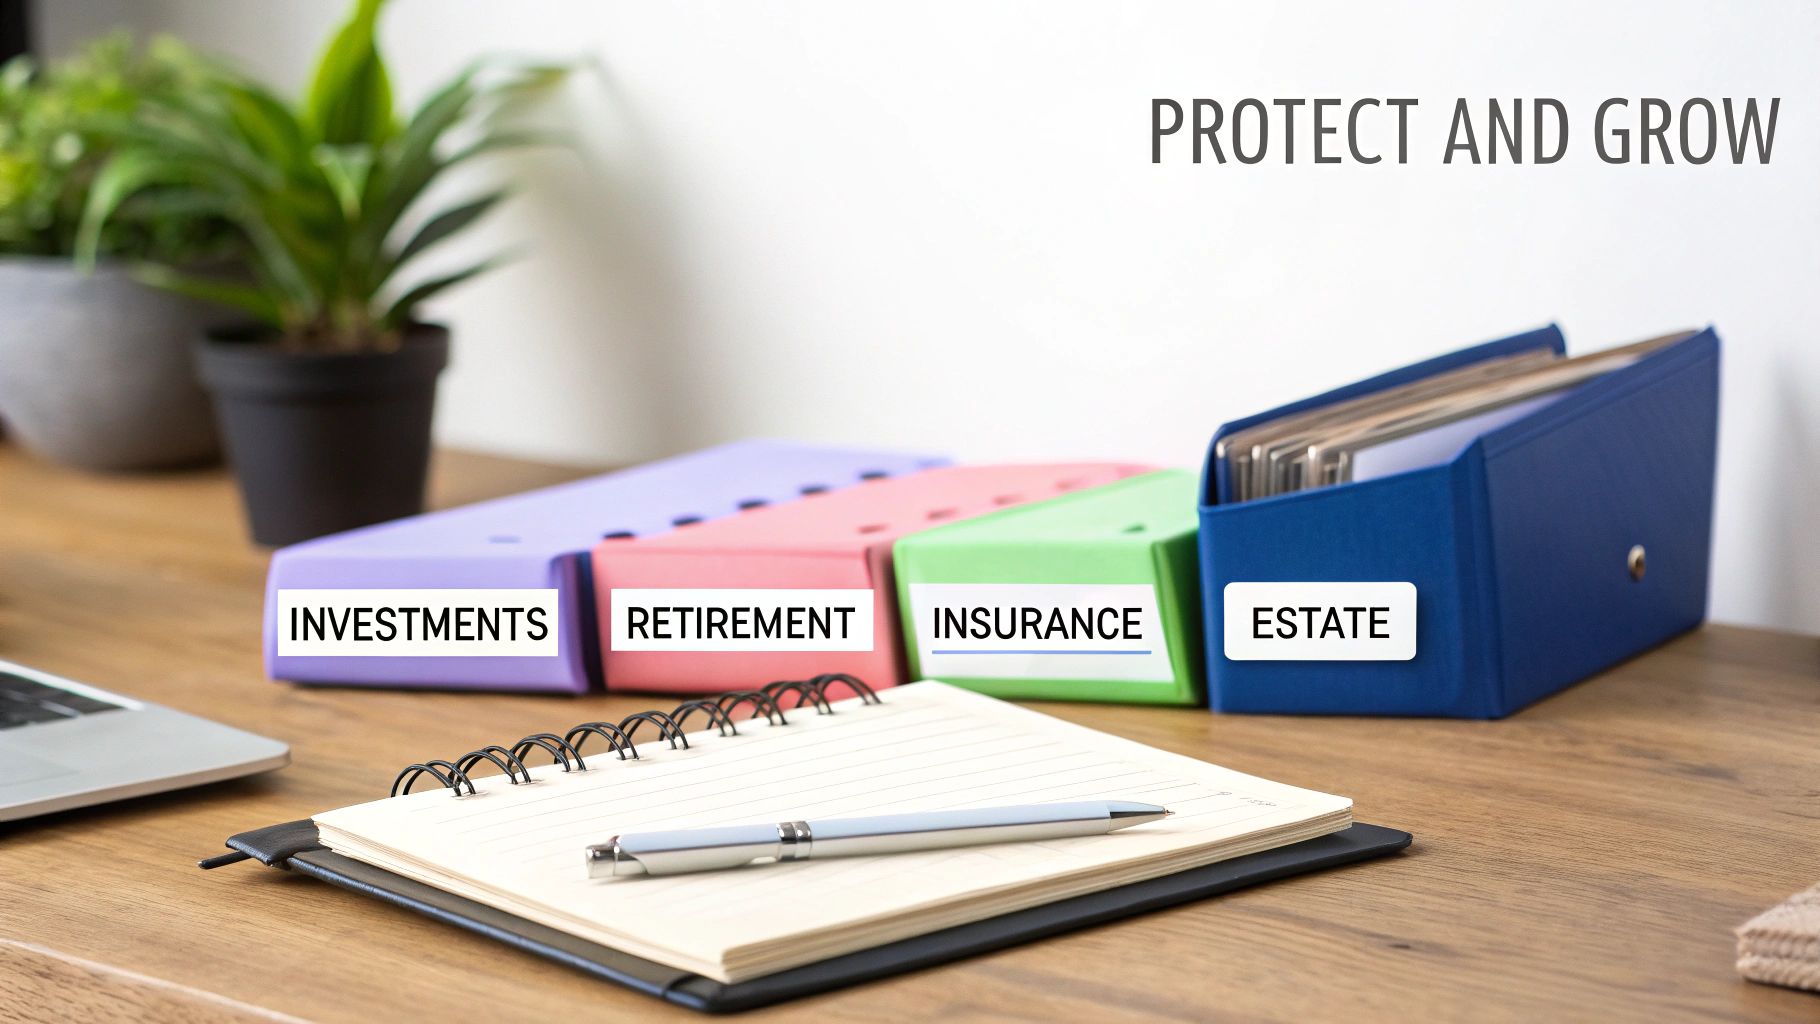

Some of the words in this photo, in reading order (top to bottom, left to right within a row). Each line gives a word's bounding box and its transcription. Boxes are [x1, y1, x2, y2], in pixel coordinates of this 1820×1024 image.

[290, 606, 549, 642] INVESTMENTS
[627, 606, 856, 640] RETIREMENT
[934, 606, 1143, 640] INSURANCE
[1252, 606, 1390, 640] ESTATE
